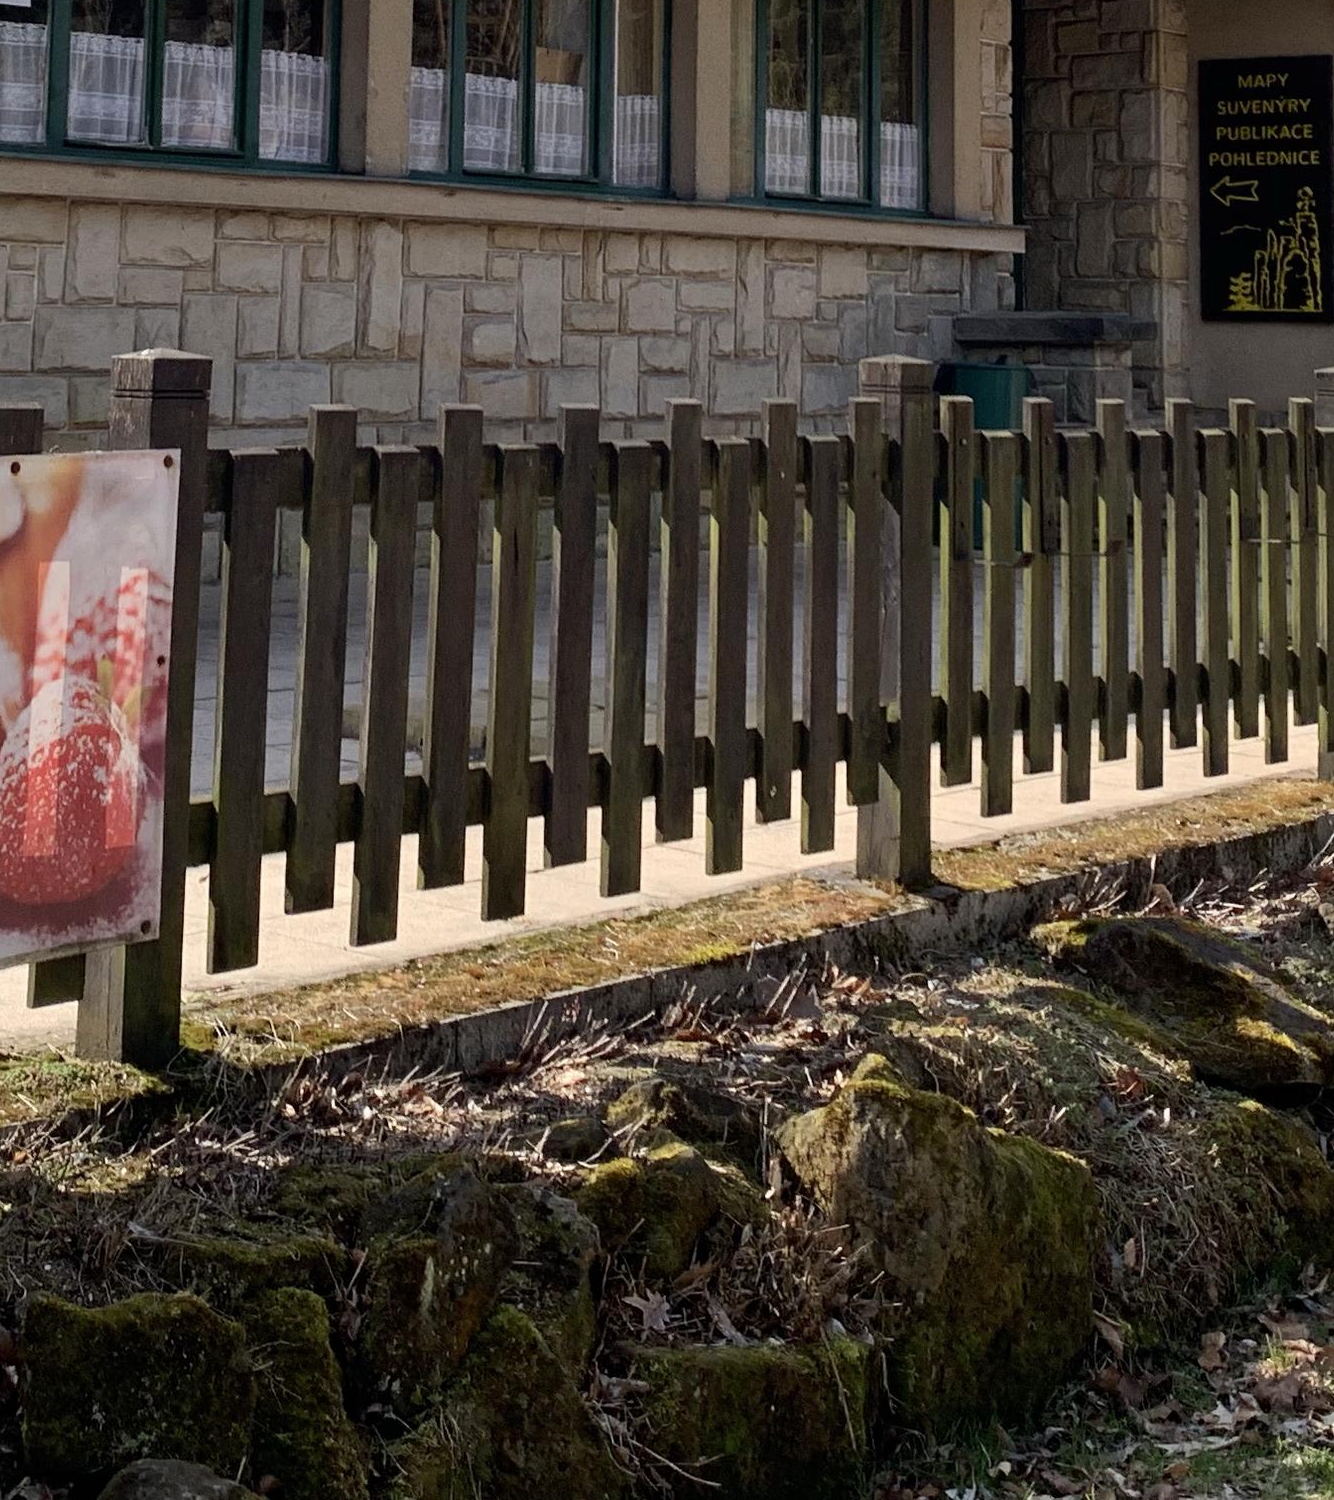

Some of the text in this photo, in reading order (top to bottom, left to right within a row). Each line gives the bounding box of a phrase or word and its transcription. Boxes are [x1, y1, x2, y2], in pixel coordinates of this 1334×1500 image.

[1238, 73, 1289, 89] MAPY
[1217, 96, 1312, 116] SUVENÝRY
[1216, 123, 1314, 141] PUBLIKACE
[1208, 150, 1321, 167] POHLEDNICE
